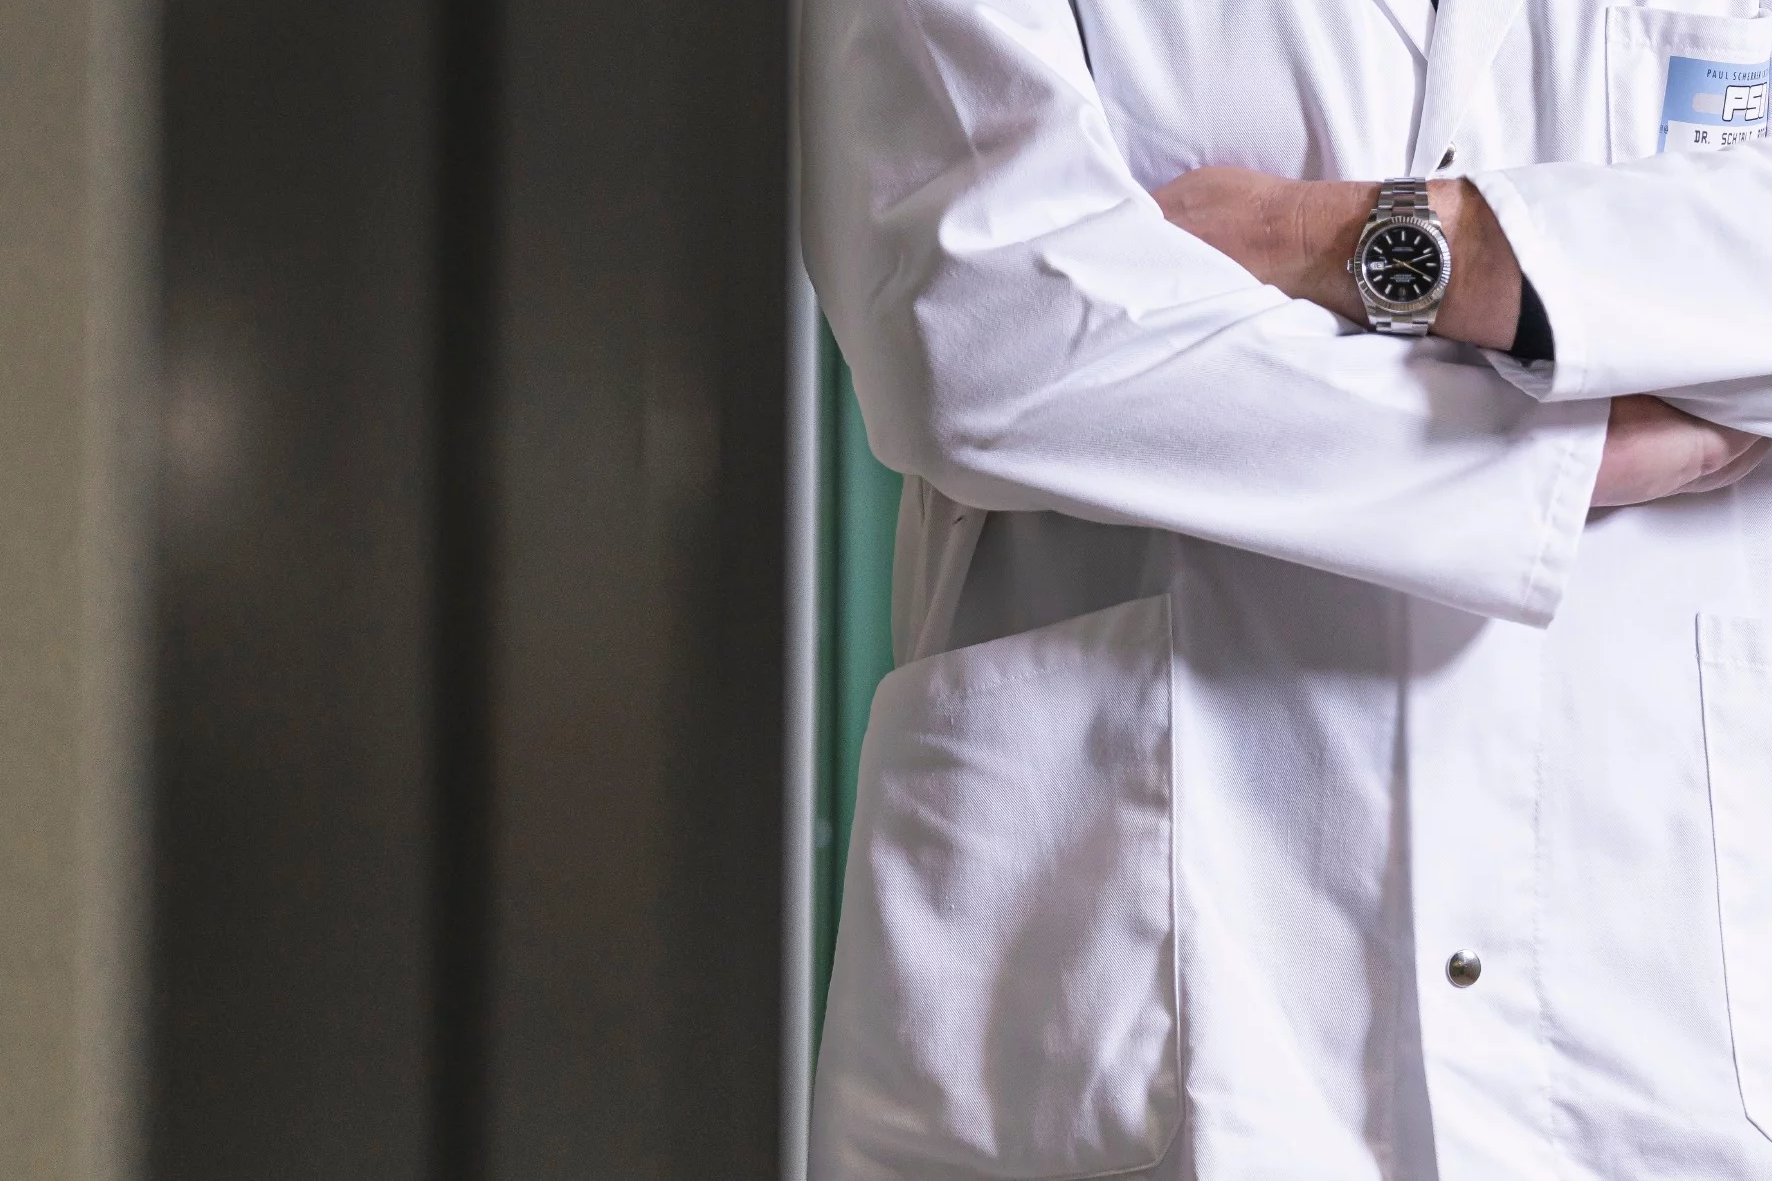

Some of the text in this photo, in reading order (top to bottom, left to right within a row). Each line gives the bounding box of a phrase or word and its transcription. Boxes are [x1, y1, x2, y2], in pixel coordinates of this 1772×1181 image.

[1706, 68, 1728, 80] PAUL
[1722, 81, 1768, 122] PSI
[1694, 130, 1711, 145] DR.
